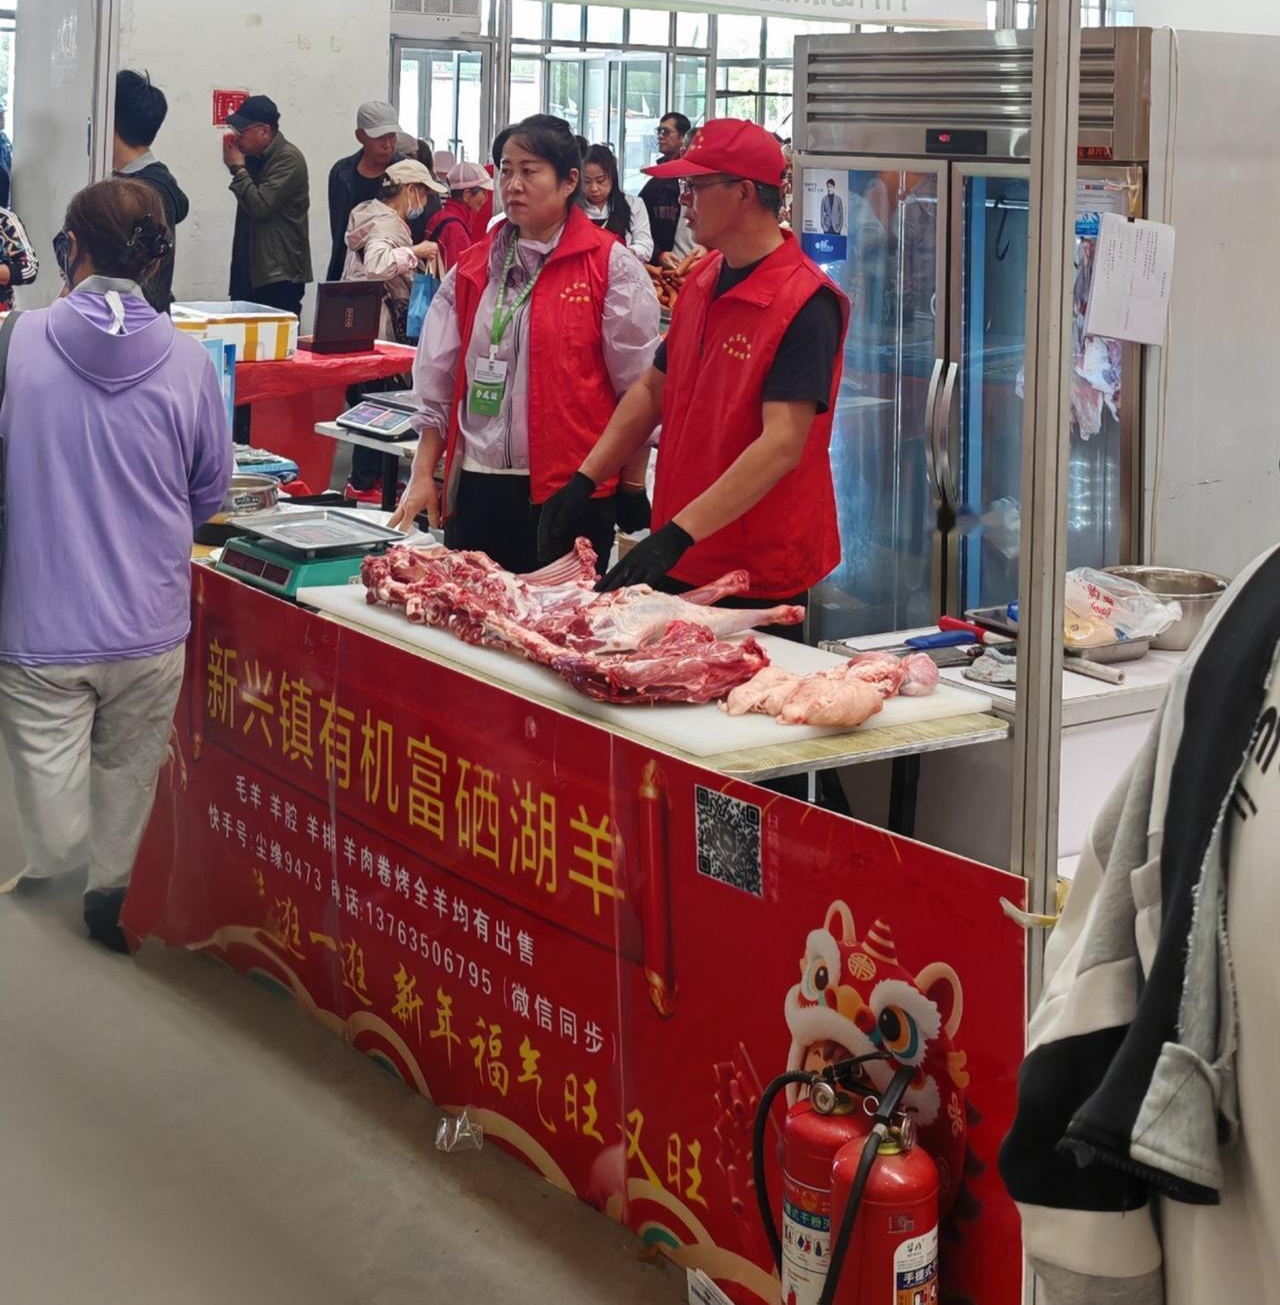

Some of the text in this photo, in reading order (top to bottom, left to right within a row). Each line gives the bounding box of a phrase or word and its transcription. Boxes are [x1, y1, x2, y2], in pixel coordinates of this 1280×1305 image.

[207, 638, 626, 916] 新兴镇有机富硒湖羊
[235, 774, 262, 811] 毛羊
[270, 792, 298, 834] 羊腔
[342, 834, 535, 968] 羊肉卷烤全羊均有出售
[252, 867, 709, 1211] 逛一逛 新年福气旺又旺
